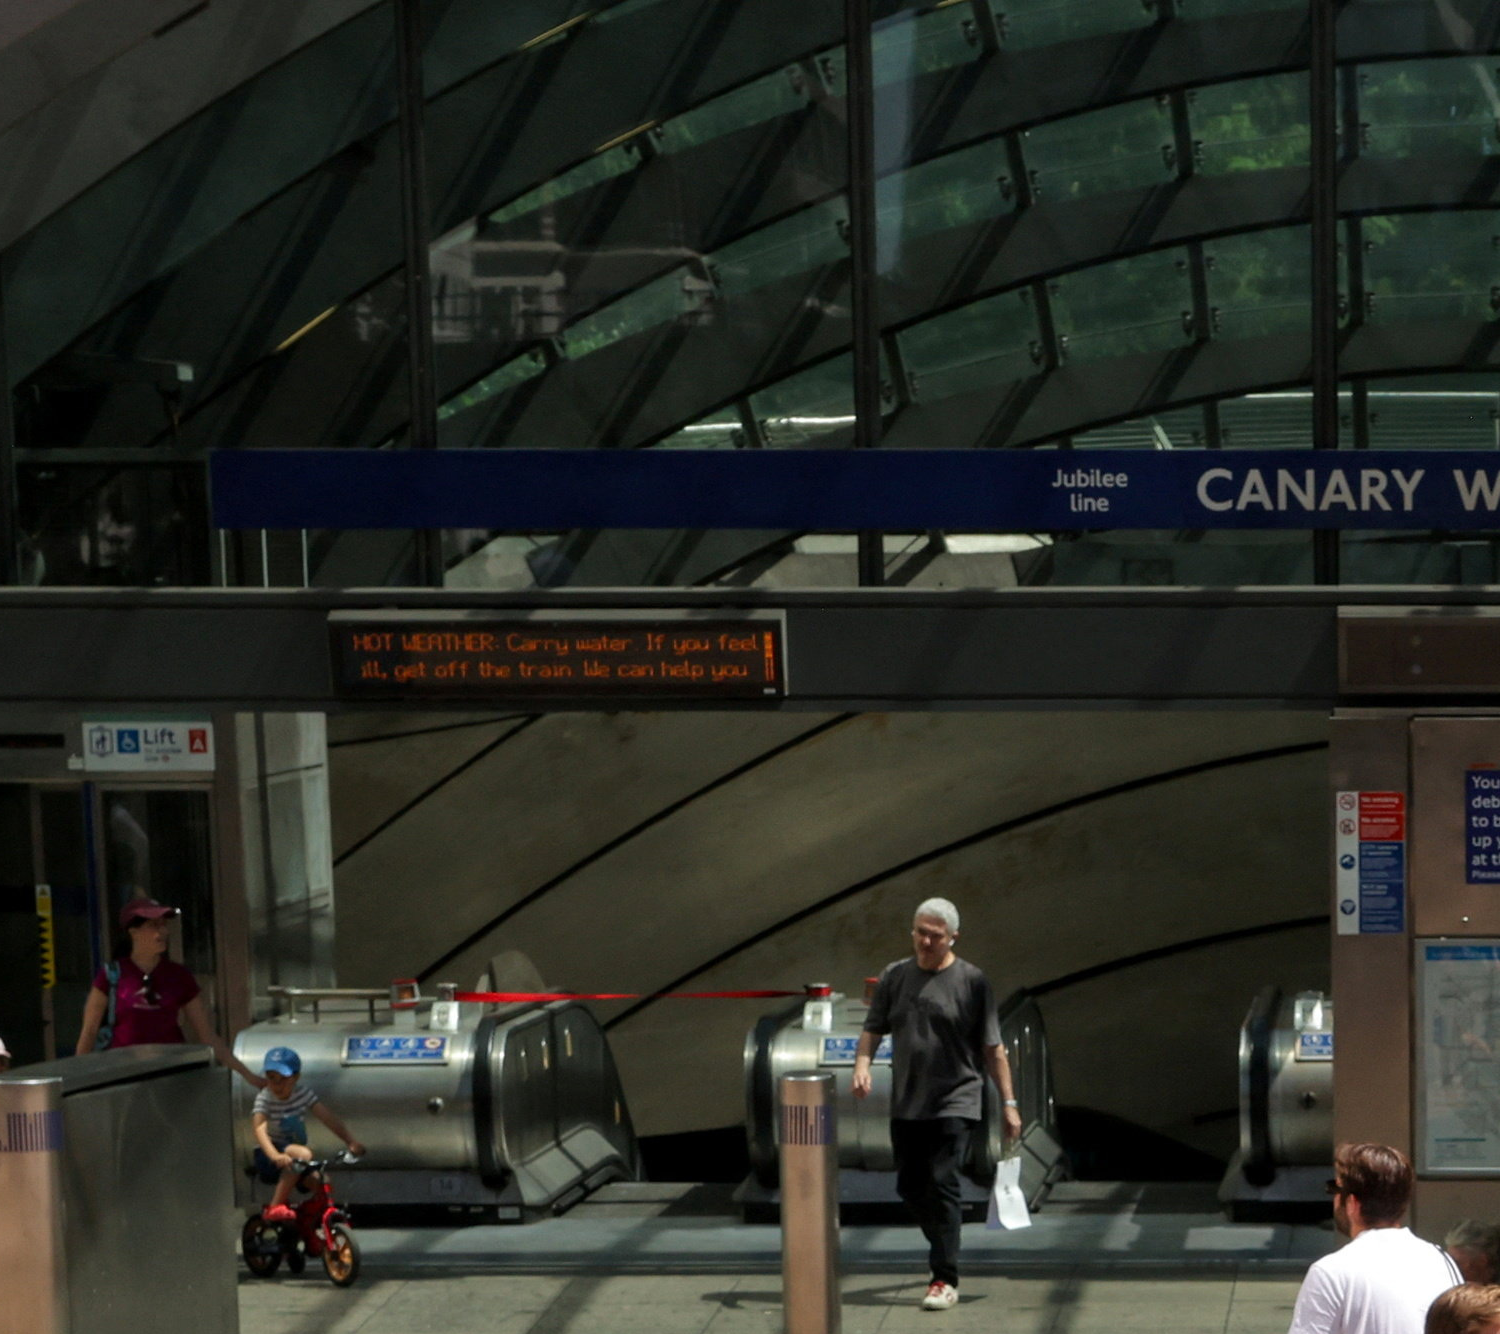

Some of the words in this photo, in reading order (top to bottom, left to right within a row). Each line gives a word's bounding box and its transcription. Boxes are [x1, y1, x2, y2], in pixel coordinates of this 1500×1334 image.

[1052, 469, 1128, 487] Jubilee
[1197, 468, 1424, 511] CANARY
[1071, 494, 1109, 511] line
[353, 633, 393, 651] HOT
[506, 634, 570, 656] Carry
[673, 639, 709, 655] you
[718, 634, 761, 651] feel
[394, 662, 427, 681] get
[433, 661, 469, 678] off
[478, 662, 511, 678] the
[582, 661, 611, 677] We
[617, 665, 654, 677] can
[660, 660, 706, 680] help
[711, 665, 749, 681] you
[143, 728, 176, 744] Lift
[1472, 776, 1500, 789] You
[1472, 816, 1489, 827] to
[1472, 836, 1492, 849] up
[1472, 854, 1487, 866] at
